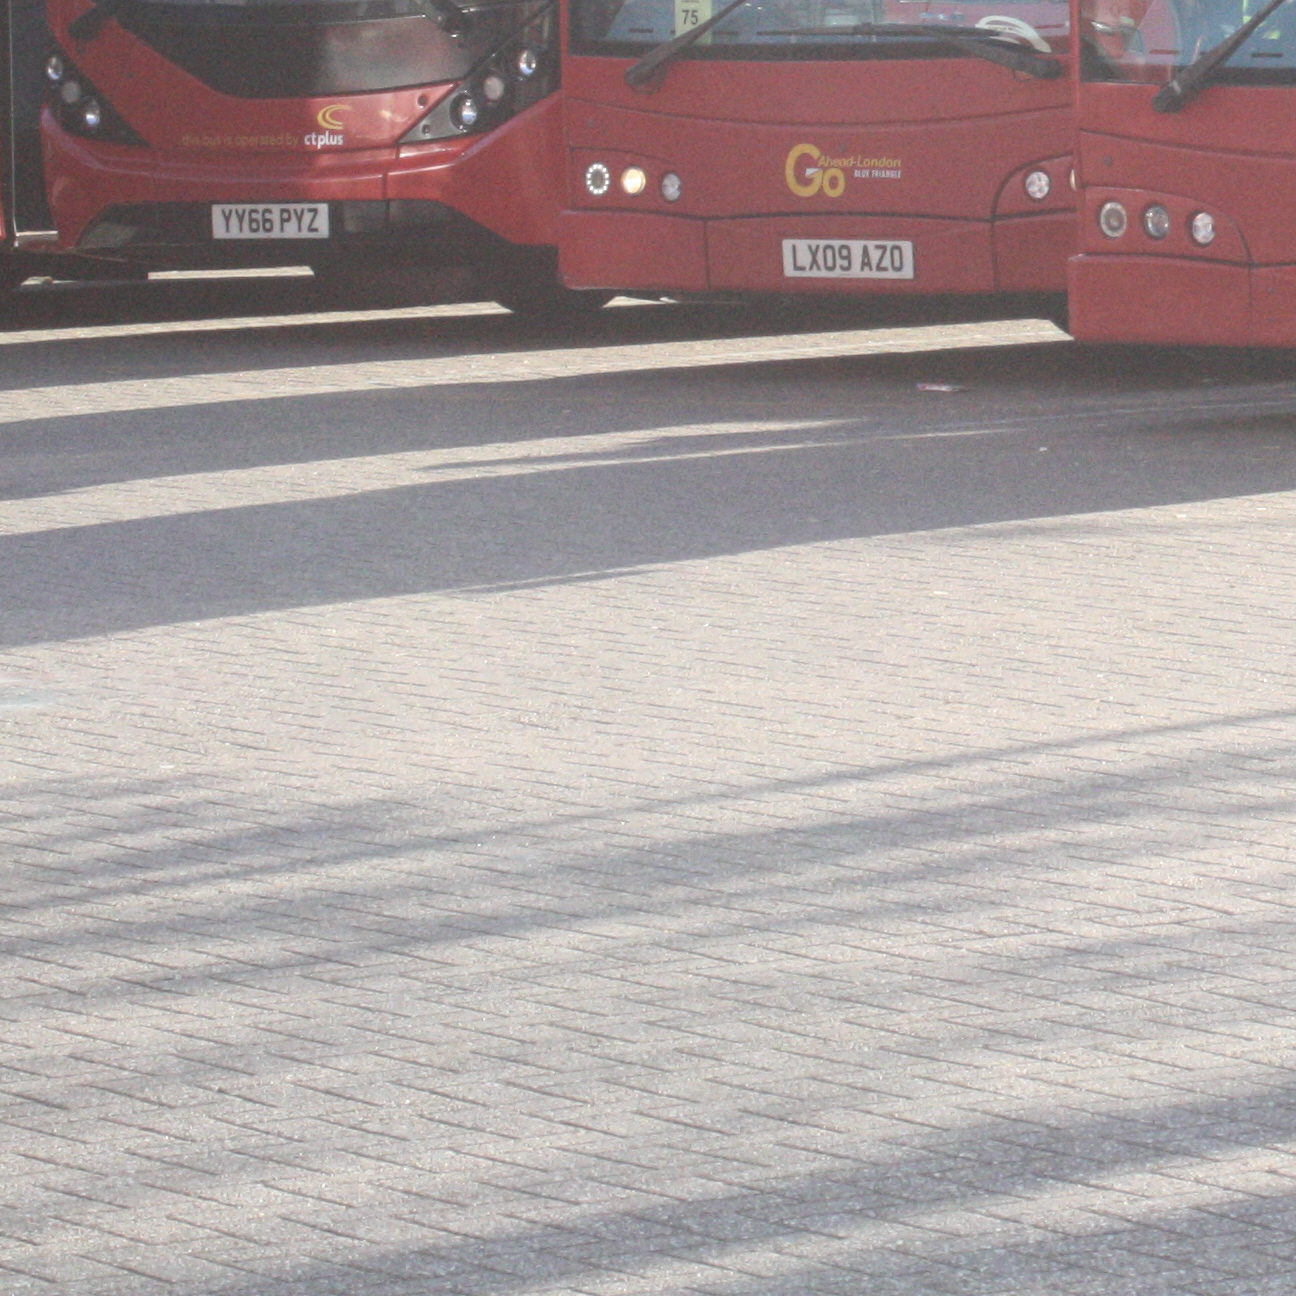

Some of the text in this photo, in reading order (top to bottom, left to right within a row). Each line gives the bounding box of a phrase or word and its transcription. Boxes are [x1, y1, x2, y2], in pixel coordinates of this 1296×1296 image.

[682, 9, 698, 25] 75
[784, 142, 845, 198] Go
[221, 207, 319, 233] YY66 PYZ
[791, 243, 852, 272] LX09
